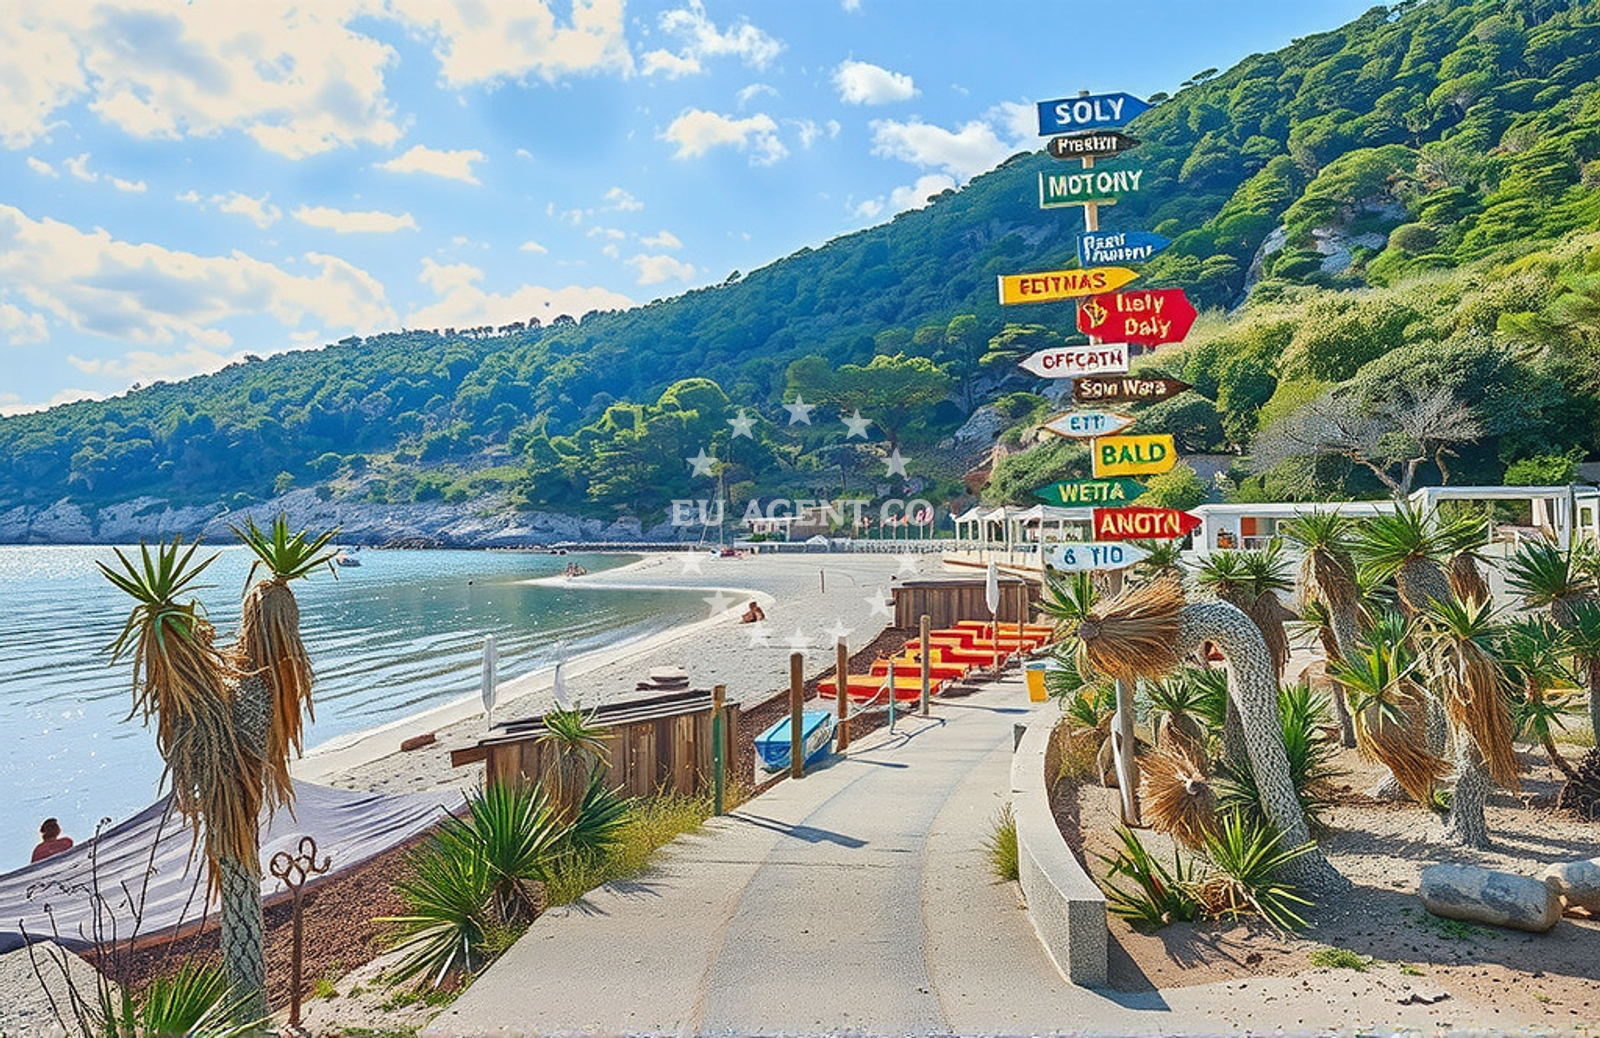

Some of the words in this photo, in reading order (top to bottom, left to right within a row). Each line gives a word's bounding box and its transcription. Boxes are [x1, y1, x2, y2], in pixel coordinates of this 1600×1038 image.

[1055, 97, 1124, 125] SOLY
[1048, 169, 1142, 197] MOTONY
[1101, 443, 1166, 465] BALD
